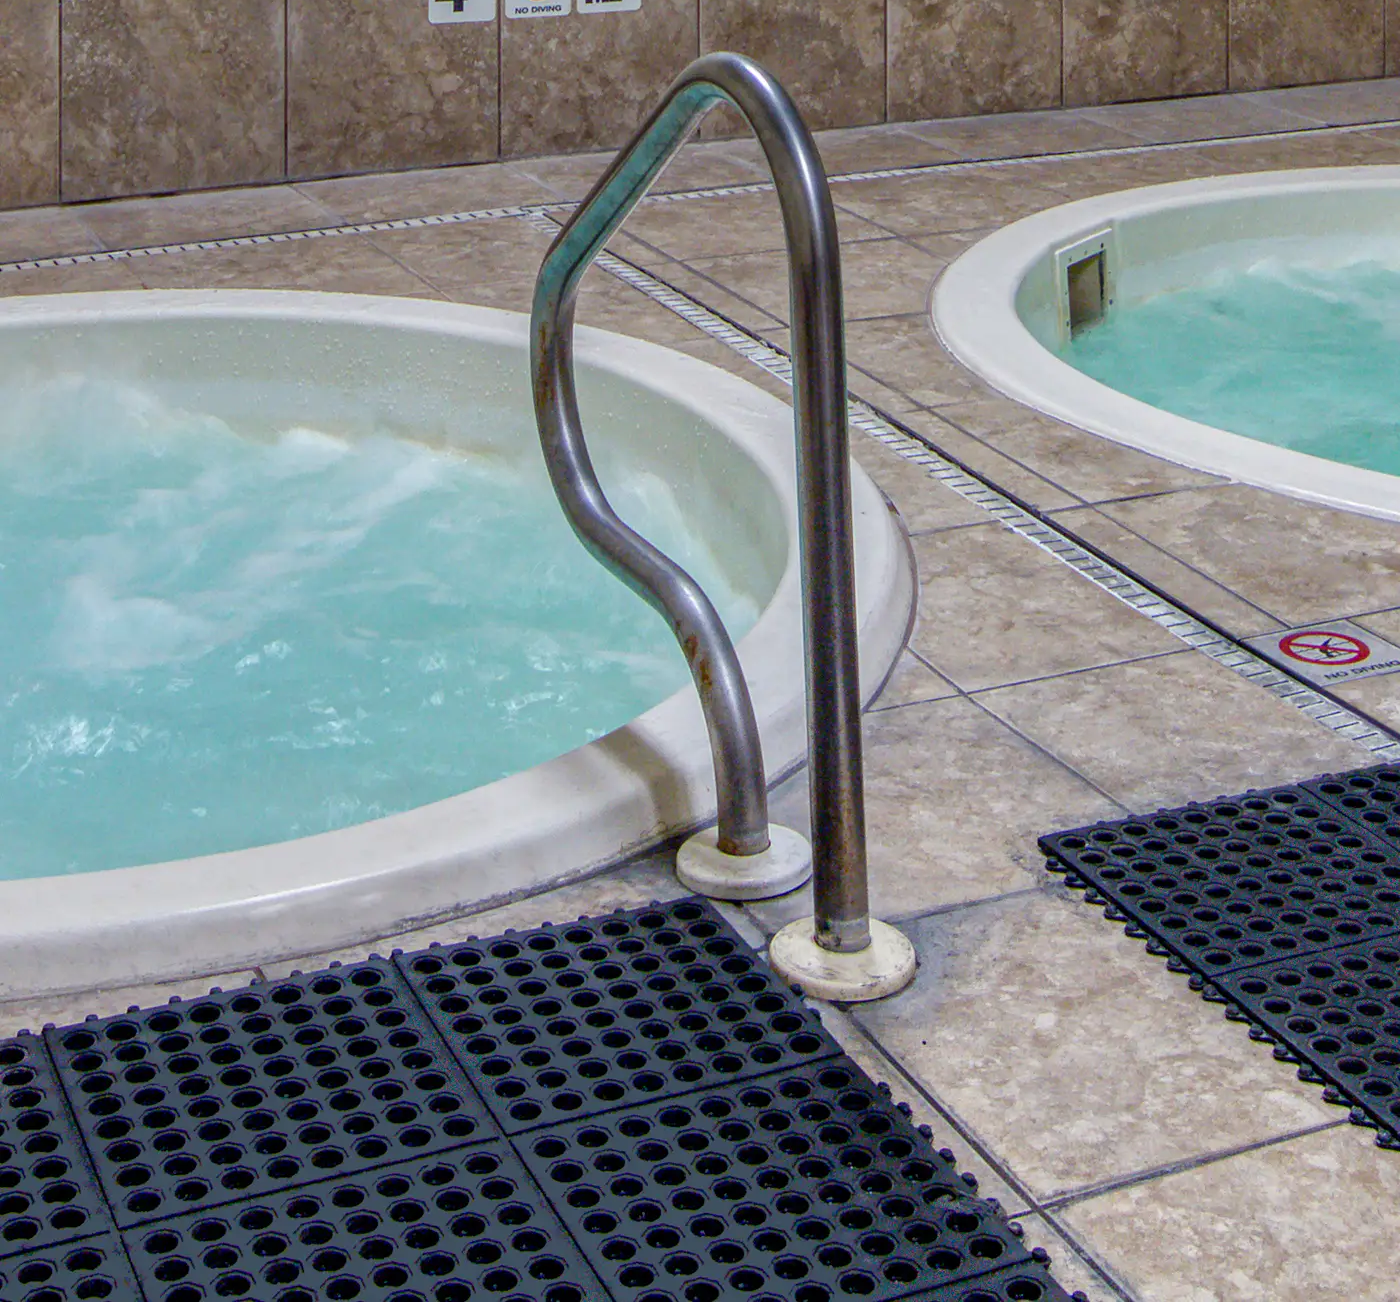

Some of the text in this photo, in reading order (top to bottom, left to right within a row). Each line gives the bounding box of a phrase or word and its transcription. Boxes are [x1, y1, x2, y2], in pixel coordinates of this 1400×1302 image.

[514, 4, 563, 15] NO DIVING
[1324, 671, 1349, 680] NO
